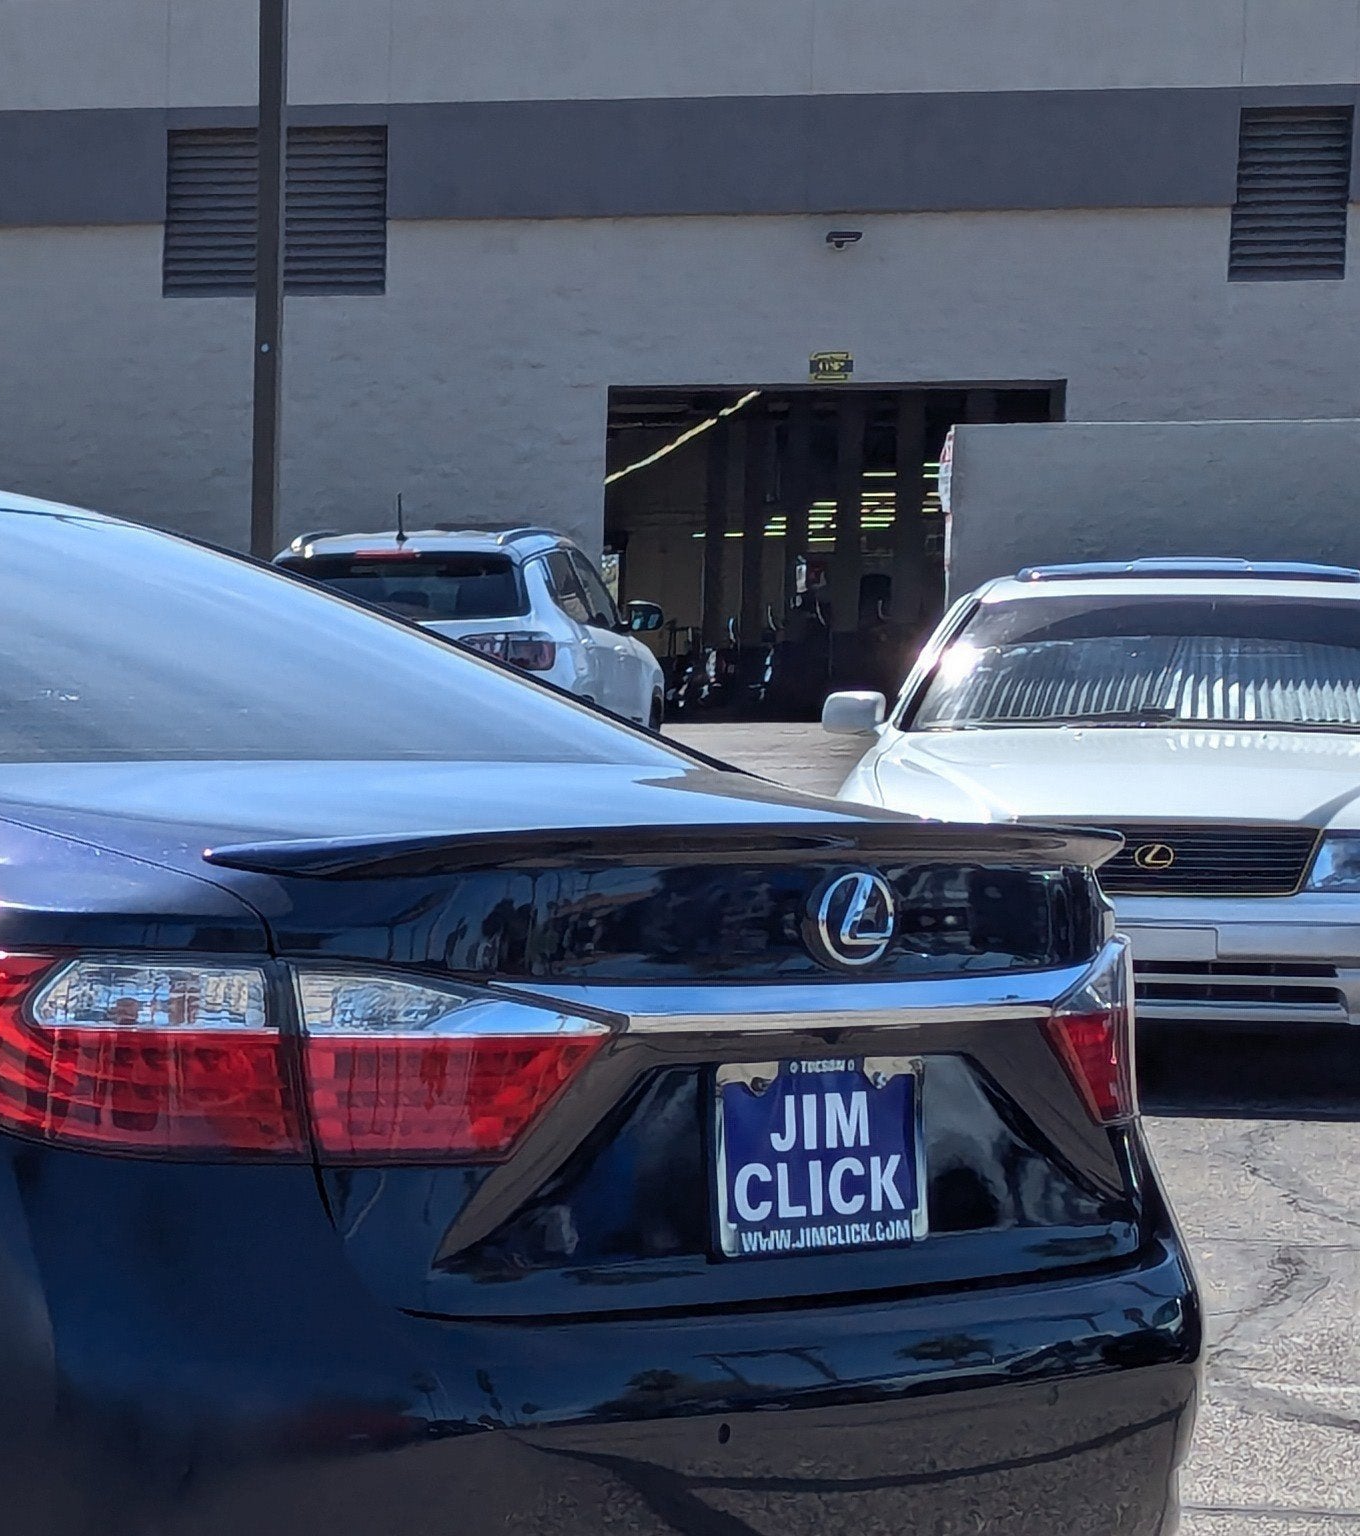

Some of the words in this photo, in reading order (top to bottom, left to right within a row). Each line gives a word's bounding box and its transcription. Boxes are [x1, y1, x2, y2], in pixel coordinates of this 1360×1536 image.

[770, 1091, 870, 1152] JIM
[734, 1154, 906, 1222] CLICK
[740, 1219, 911, 1252] WWW.JIMCLICK.COM
